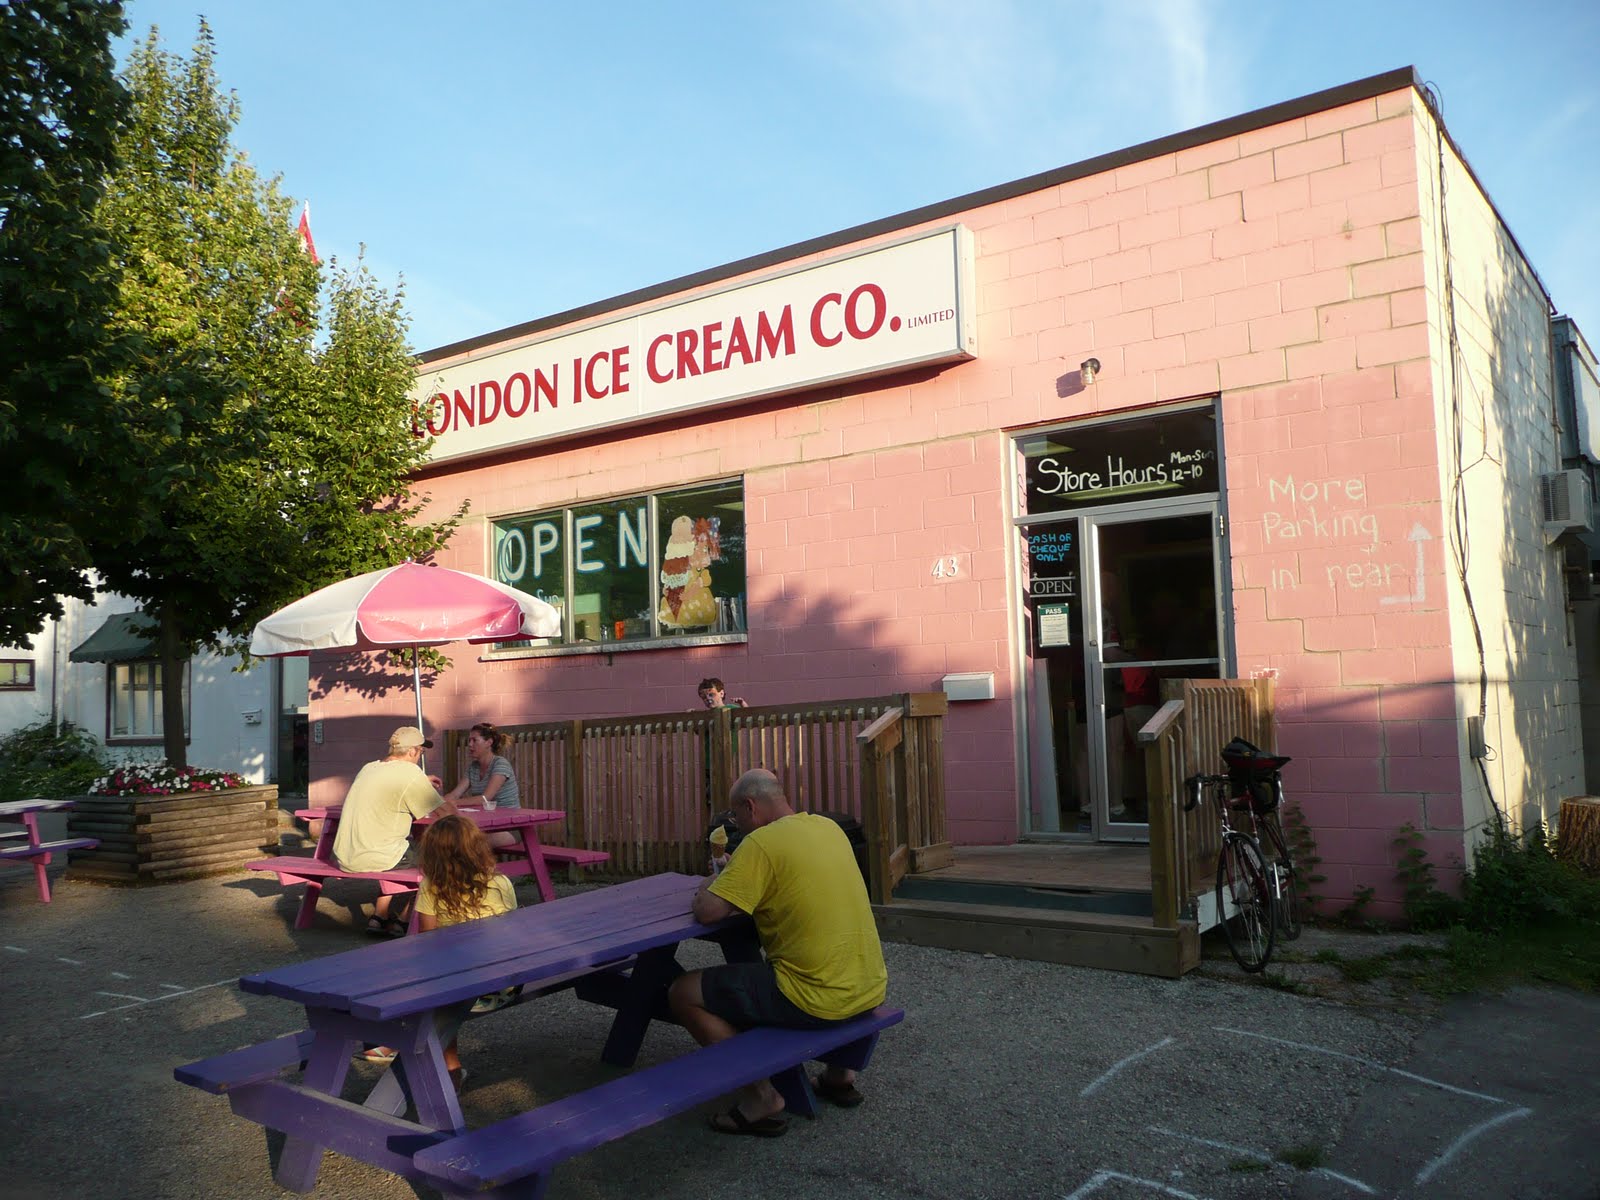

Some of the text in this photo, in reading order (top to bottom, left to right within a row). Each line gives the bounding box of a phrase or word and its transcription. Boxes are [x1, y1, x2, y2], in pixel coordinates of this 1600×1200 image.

[411, 283, 955, 439] LONDON ICE CREAM CO. LIMITED
[1036, 455, 1168, 494] Store Hours
[1172, 464, 1203, 482] 12-10
[1269, 474, 1365, 502] More
[1028, 533, 1072, 545] CASH OR
[1263, 507, 1379, 553] Parking
[500, 508, 648, 582] OPEN
[1029, 543, 1071, 554] CHEQUE
[1036, 552, 1065, 562] ONLY
[931, 556, 960, 580] 43
[1270, 560, 1406, 592] in rear
[1033, 580, 1073, 594] OPEN
[1045, 607, 1062, 615] PASS
